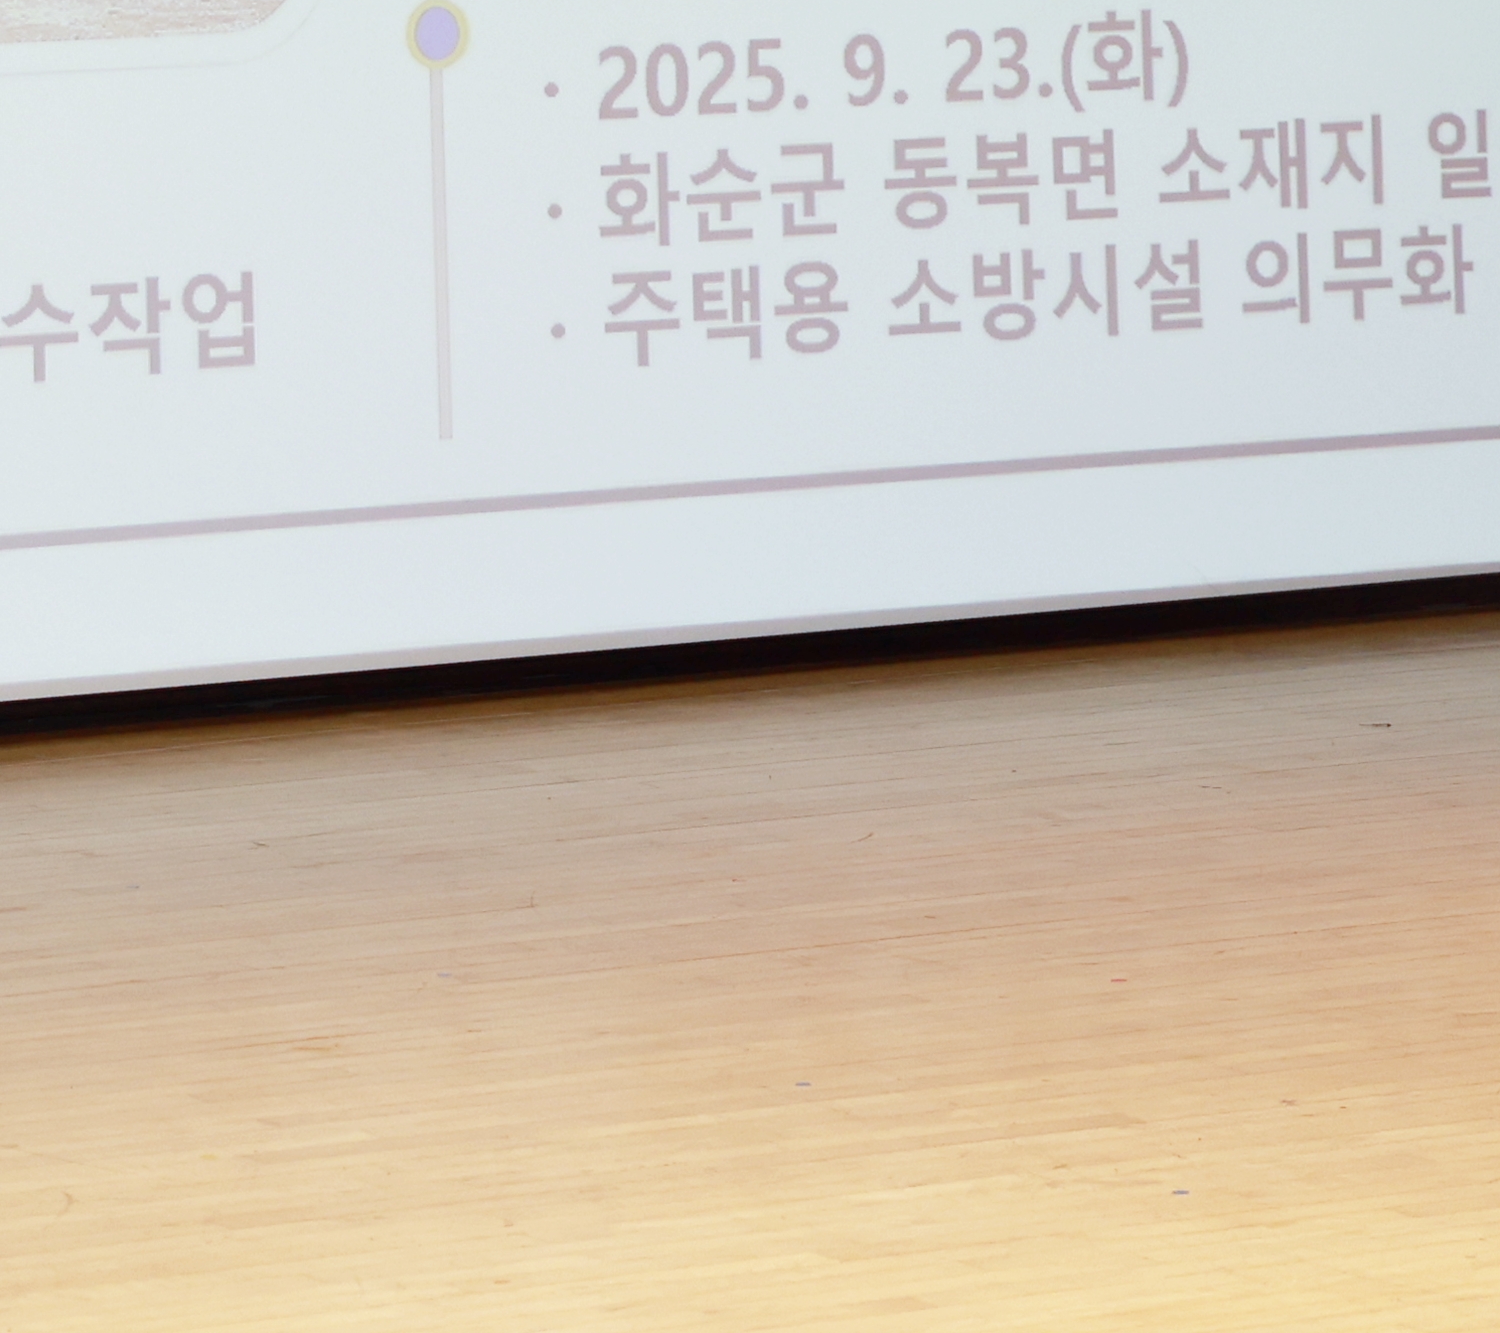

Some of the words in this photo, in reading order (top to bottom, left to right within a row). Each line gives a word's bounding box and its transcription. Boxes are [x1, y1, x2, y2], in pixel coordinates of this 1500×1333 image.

[598, 38, 809, 121] 2025.
[843, 33, 909, 107] 9.
[945, 8, 1189, 113] 23.(화)
[599, 142, 845, 247] 화순군
[884, 128, 1119, 230] 동복면
[1158, 113, 1385, 210] 소재지
[604, 260, 849, 367] 주택용
[888, 238, 1204, 342] 소방시설
[1242, 223, 1474, 324] 의무화
